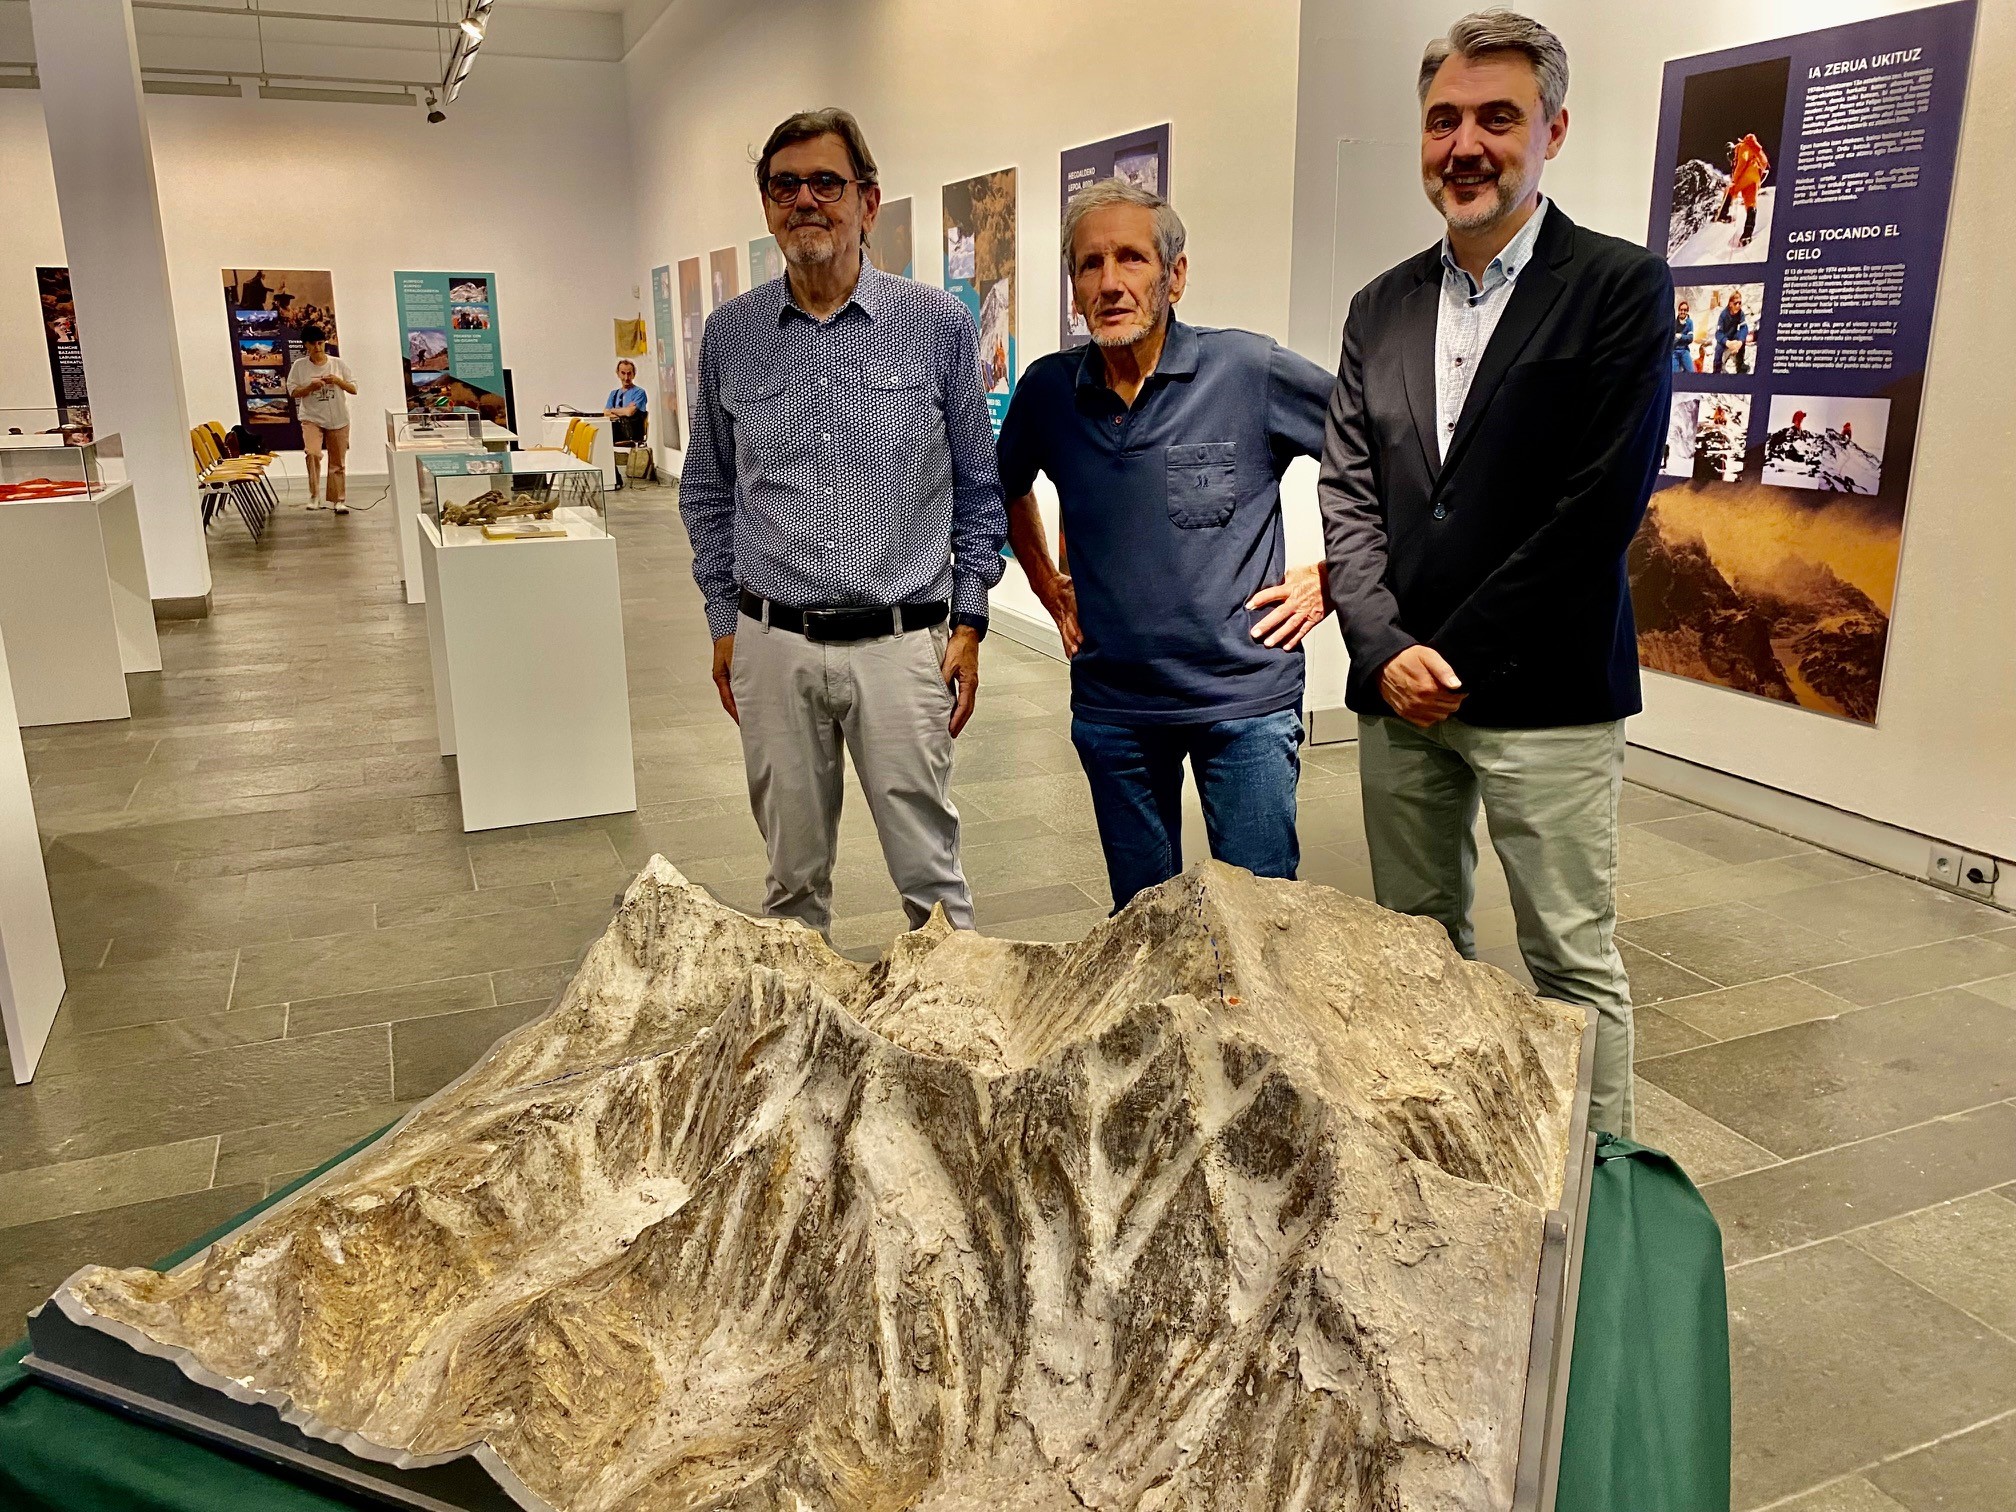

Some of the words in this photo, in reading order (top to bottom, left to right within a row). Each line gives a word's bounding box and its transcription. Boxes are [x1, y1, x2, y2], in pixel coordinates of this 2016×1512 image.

[1809, 66, 1821, 79] IA
[1824, 58, 1868, 76] ZERUA
[1871, 48, 1922, 67] UKITUZ
[1788, 231, 1816, 243] CASI
[1819, 226, 1881, 241] TOCANDO
[1884, 224, 1900, 236] EL
[1786, 248, 1821, 260] CIELO
